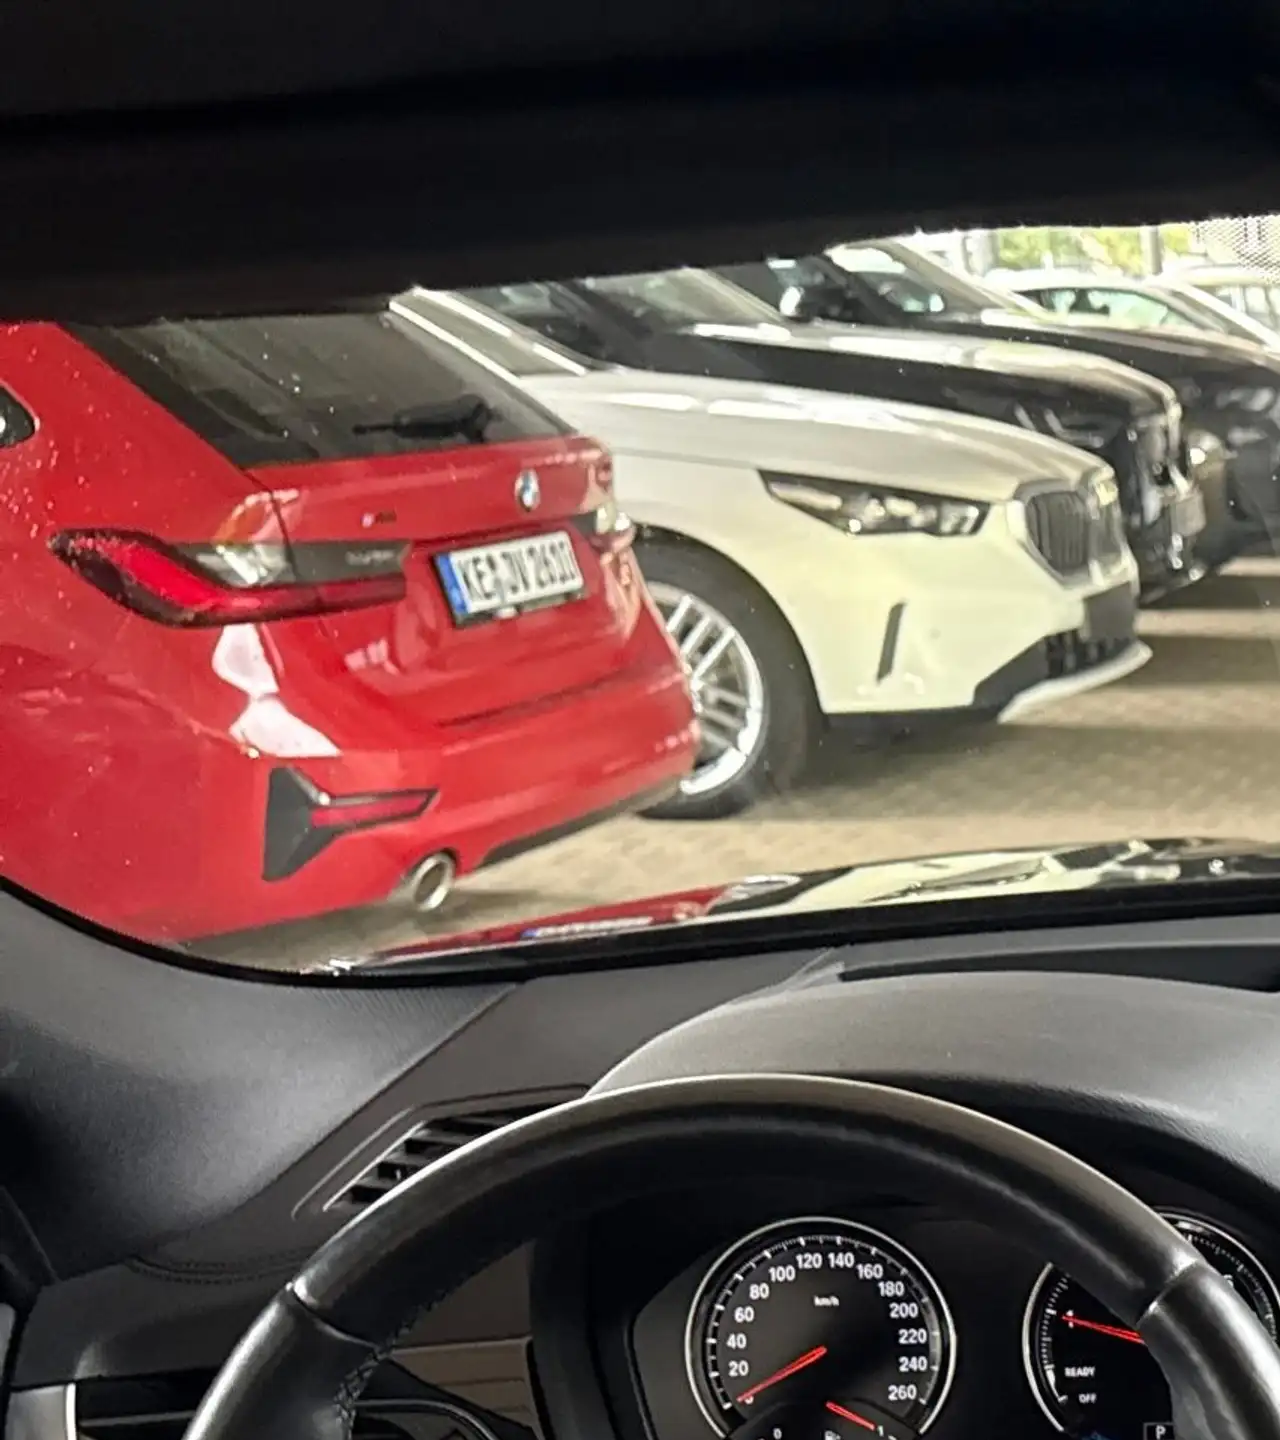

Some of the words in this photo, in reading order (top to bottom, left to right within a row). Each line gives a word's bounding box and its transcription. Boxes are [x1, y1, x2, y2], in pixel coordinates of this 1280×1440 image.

[796, 1252, 823, 1269] 120
[828, 1251, 855, 1268] 140
[768, 1265, 796, 1282] 100
[856, 1263, 884, 1280] 160
[749, 1282, 770, 1299] 80
[878, 1280, 905, 1297] 180
[813, 1295, 840, 1307] km/h
[734, 1306, 755, 1322] 60
[889, 1302, 919, 1319] 200
[726, 1333, 747, 1349] 40
[898, 1328, 928, 1344] 220
[728, 1360, 749, 1377] 20
[898, 1355, 928, 1372] 240
[1064, 1366, 1096, 1378] READY
[888, 1384, 918, 1401] 260
[1078, 1393, 1097, 1404] OFF
[773, 1427, 783, 1440] 0
[1155, 1425, 1166, 1440] P
